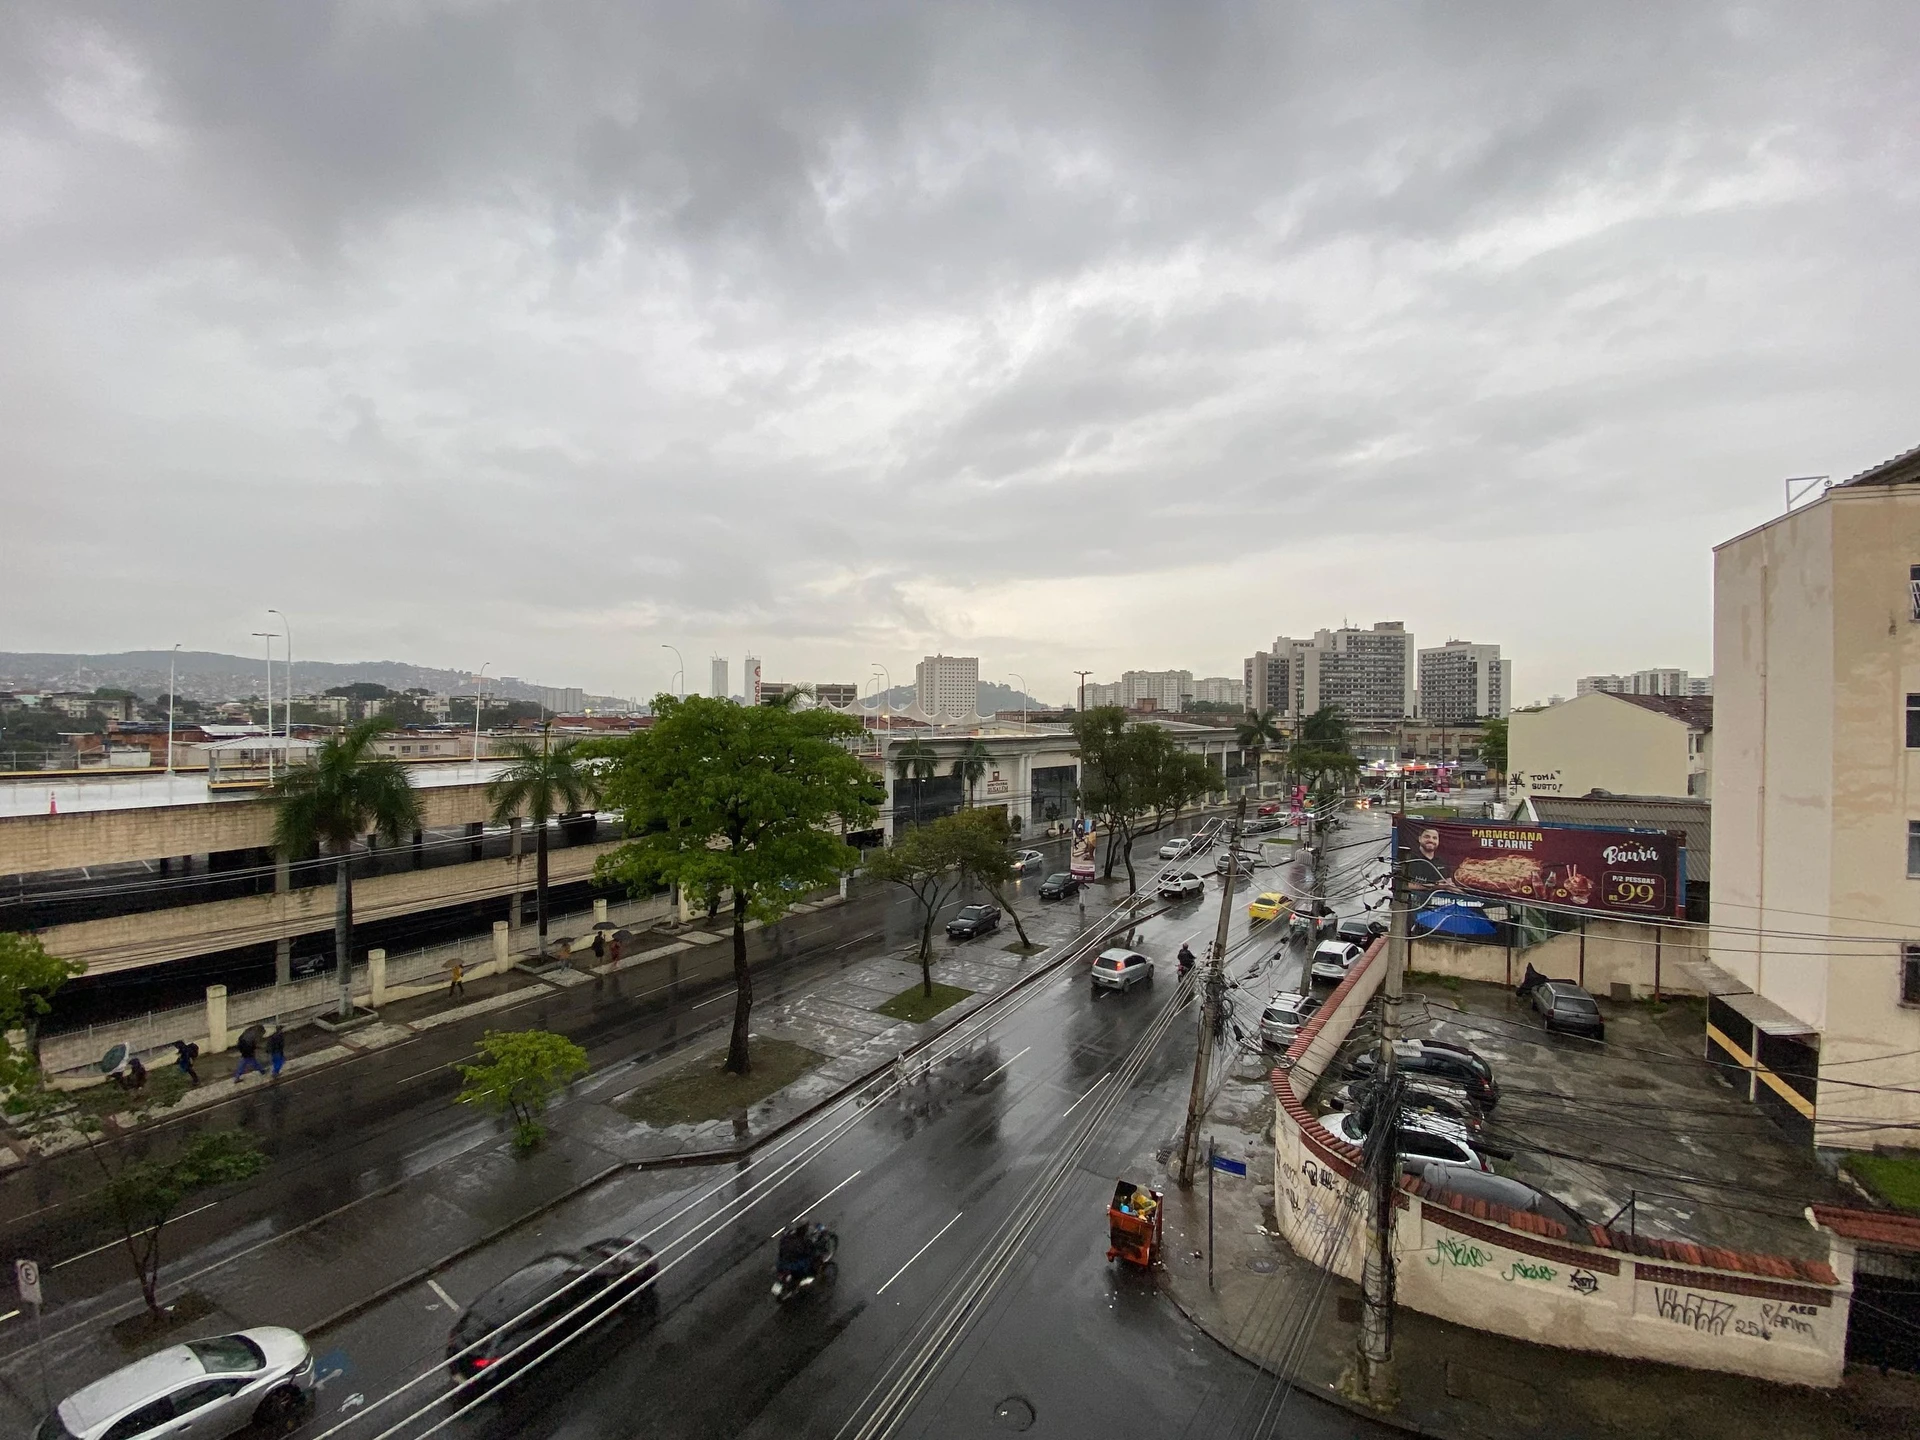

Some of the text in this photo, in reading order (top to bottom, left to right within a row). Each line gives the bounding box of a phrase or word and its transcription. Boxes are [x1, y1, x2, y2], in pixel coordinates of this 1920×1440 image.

[1530, 773, 1556, 782] TOMA
[1531, 783, 1563, 793] SUSTO!
[1472, 828, 1543, 841] PARMEGIANA
[1481, 838, 1494, 847] DE
[1497, 839, 1533, 850] CARNE
[1602, 846, 1659, 865] Baurú
[1625, 876, 1656, 885] PESSOAS
[1617, 883, 1655, 904] 99
